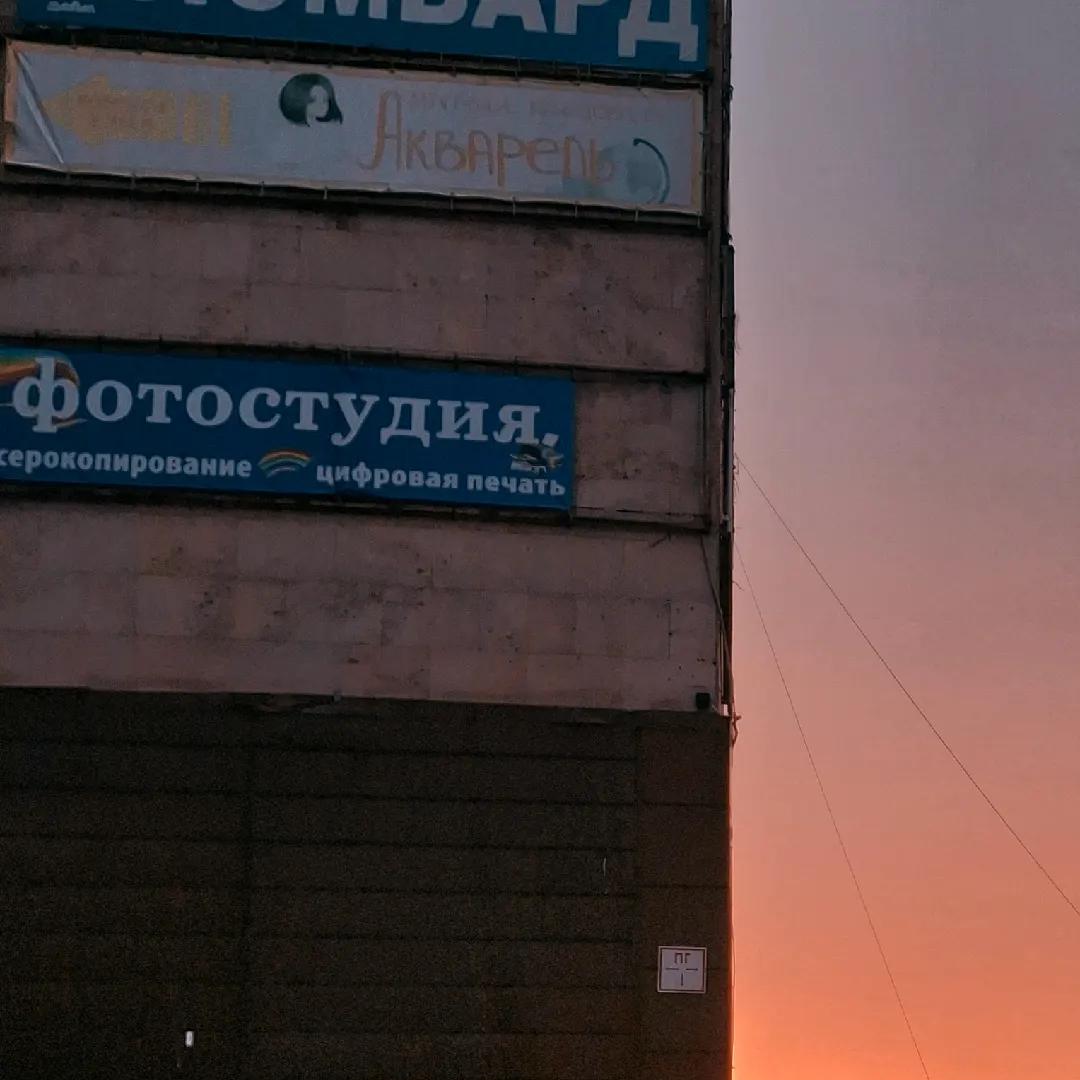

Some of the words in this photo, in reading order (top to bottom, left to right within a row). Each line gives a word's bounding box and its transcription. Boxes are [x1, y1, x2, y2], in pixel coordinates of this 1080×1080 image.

[316, 461, 459, 489] цифровая
[466, 472, 566, 496] печать
[674, 952, 691, 964] ПГ
